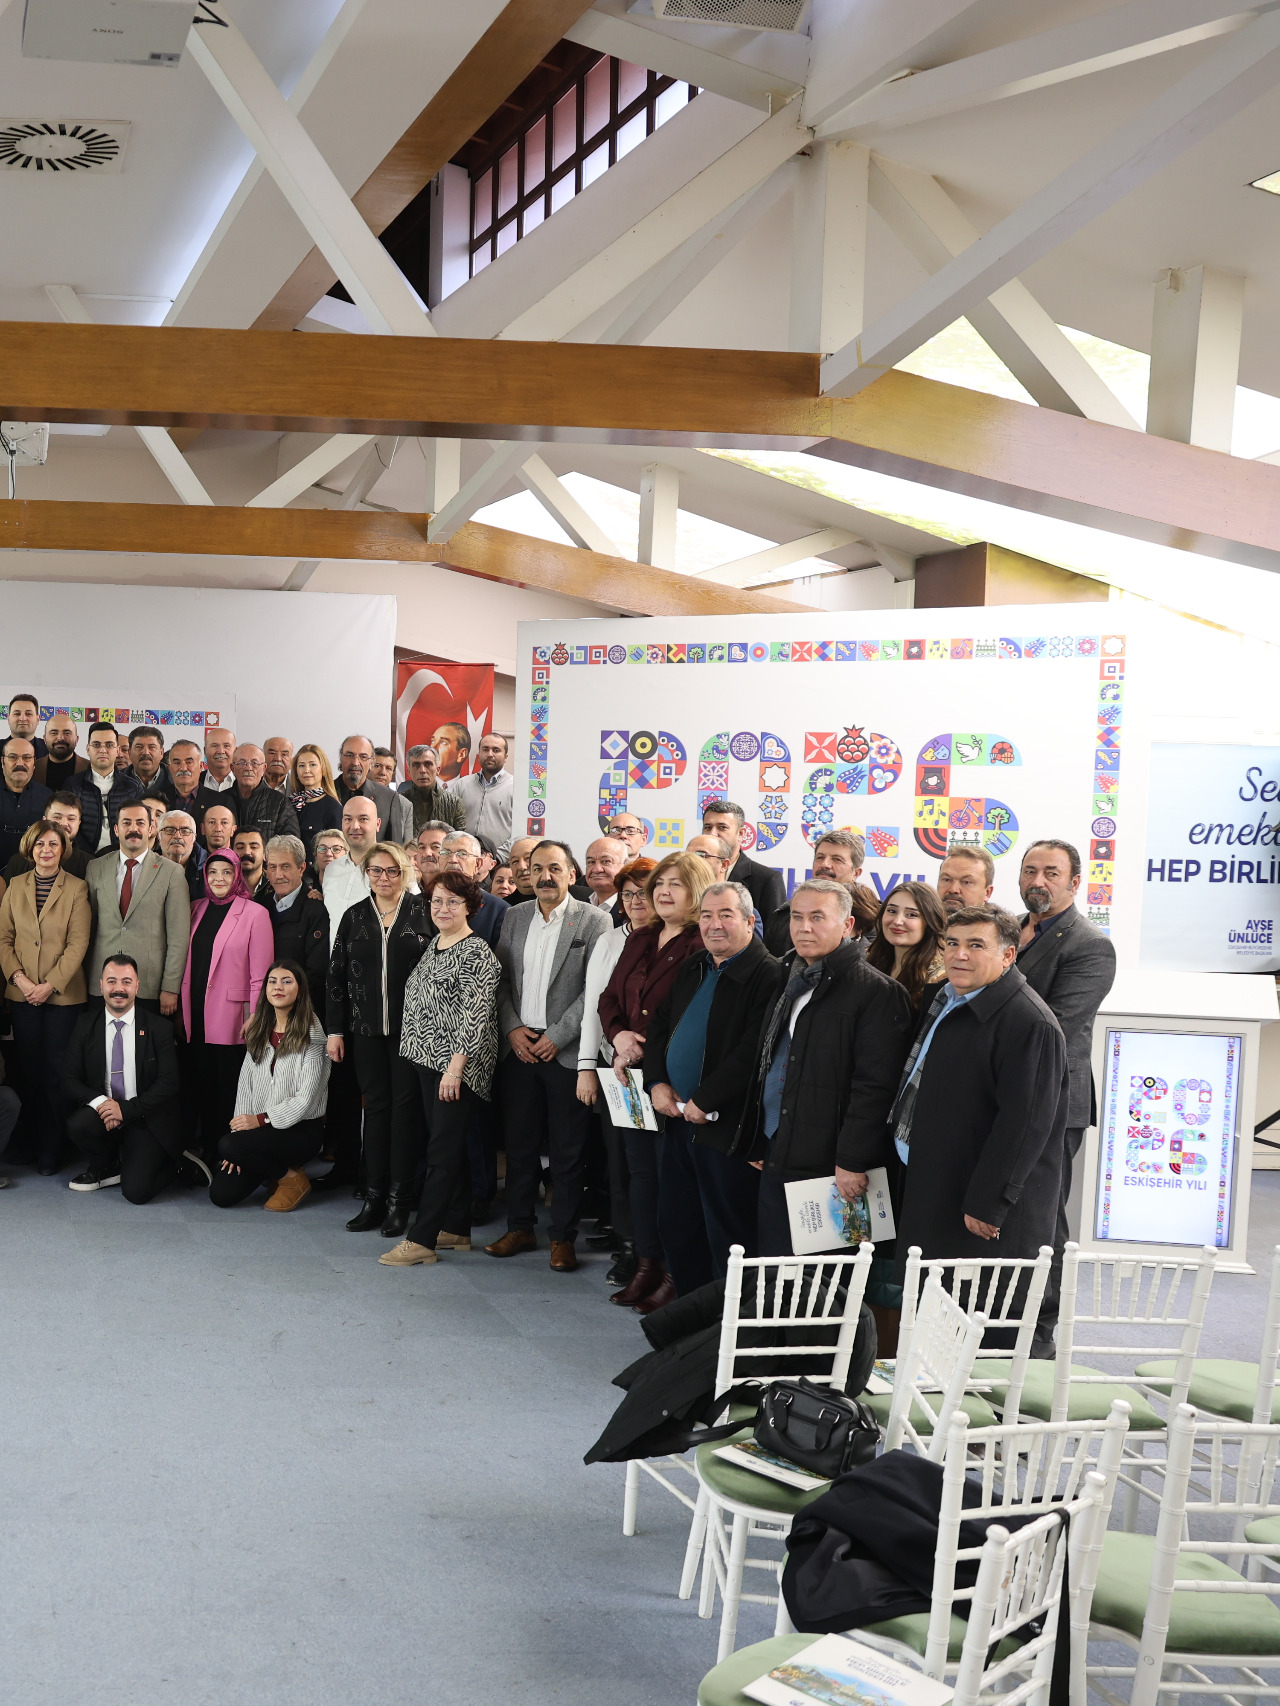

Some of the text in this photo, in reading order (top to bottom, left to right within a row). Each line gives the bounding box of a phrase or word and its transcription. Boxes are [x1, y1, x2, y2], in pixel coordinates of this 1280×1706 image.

[1147, 854, 1280, 883] HEP BİRLİ
[1246, 920, 1273, 932] AYŞE
[1228, 930, 1273, 943] ÜNLÜCE
[1124, 1175, 1207, 1191] ESKİŞEHİR YILI
